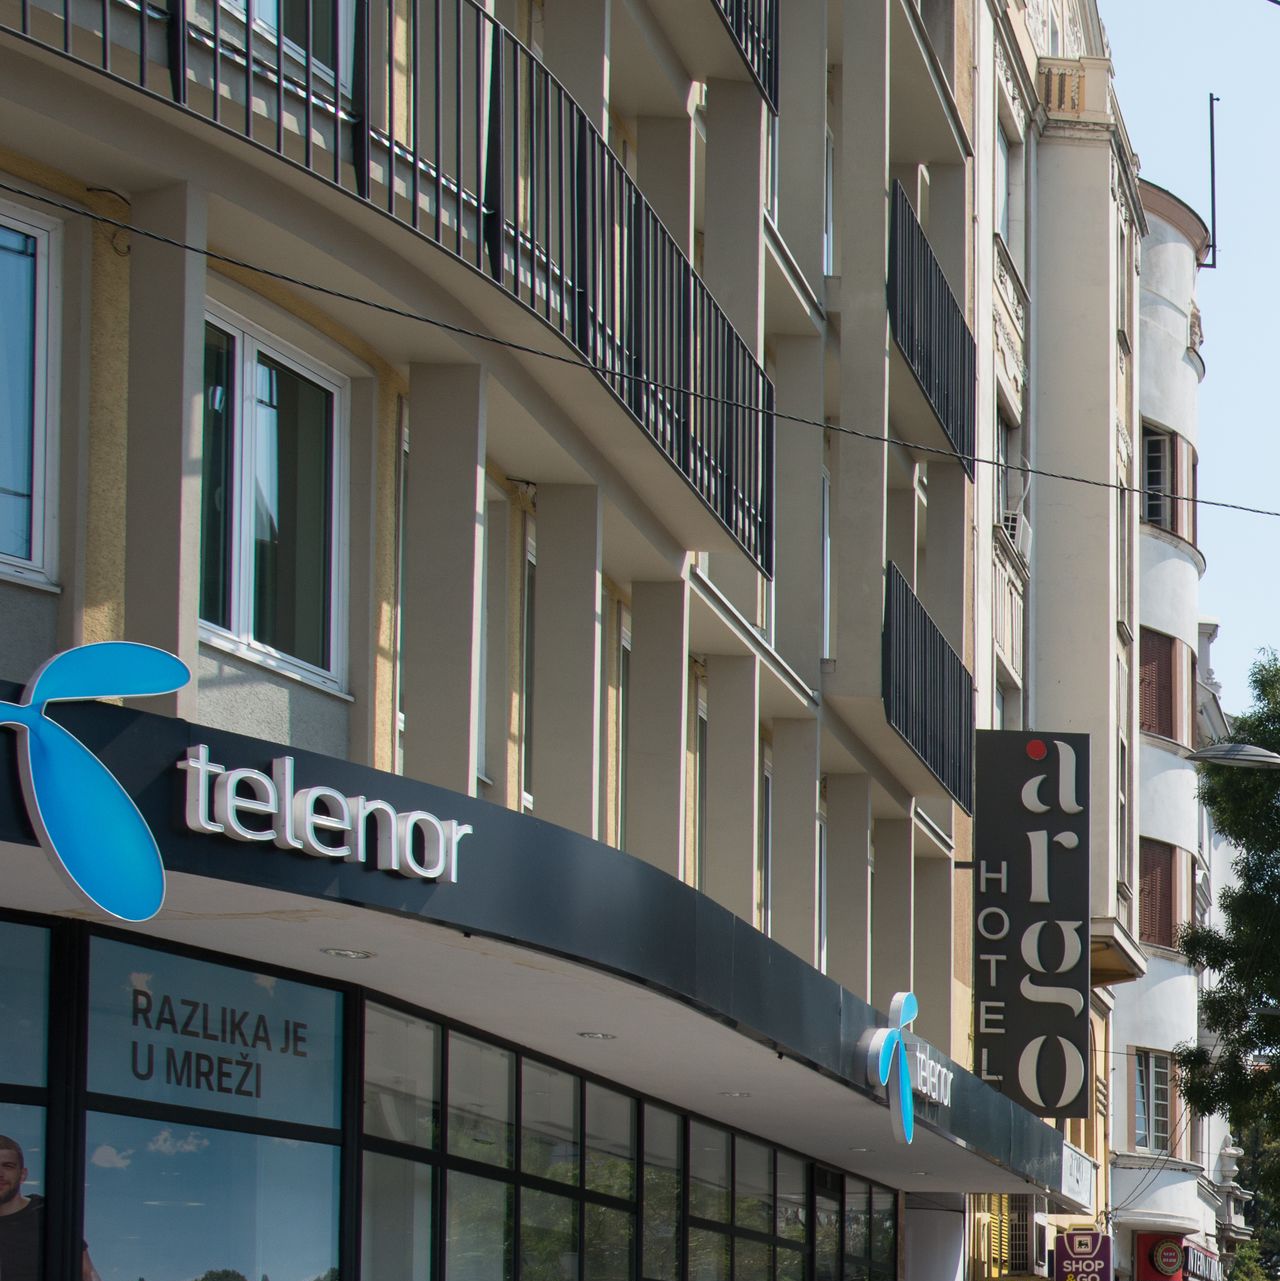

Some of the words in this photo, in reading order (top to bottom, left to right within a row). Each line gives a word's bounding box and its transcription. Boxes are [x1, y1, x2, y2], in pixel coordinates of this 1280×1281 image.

[177, 743, 473, 884] telenor
[1019, 740, 1085, 1109] argo
[979, 858, 1011, 1082] HOTEL
[132, 988, 272, 1051] RAZLIKA
[280, 1018, 309, 1058] JE
[131, 1040, 155, 1081] U
[165, 1049, 262, 1099] MREŽI
[915, 1042, 954, 1108] telenor
[1062, 1259, 1105, 1273] SHOP
